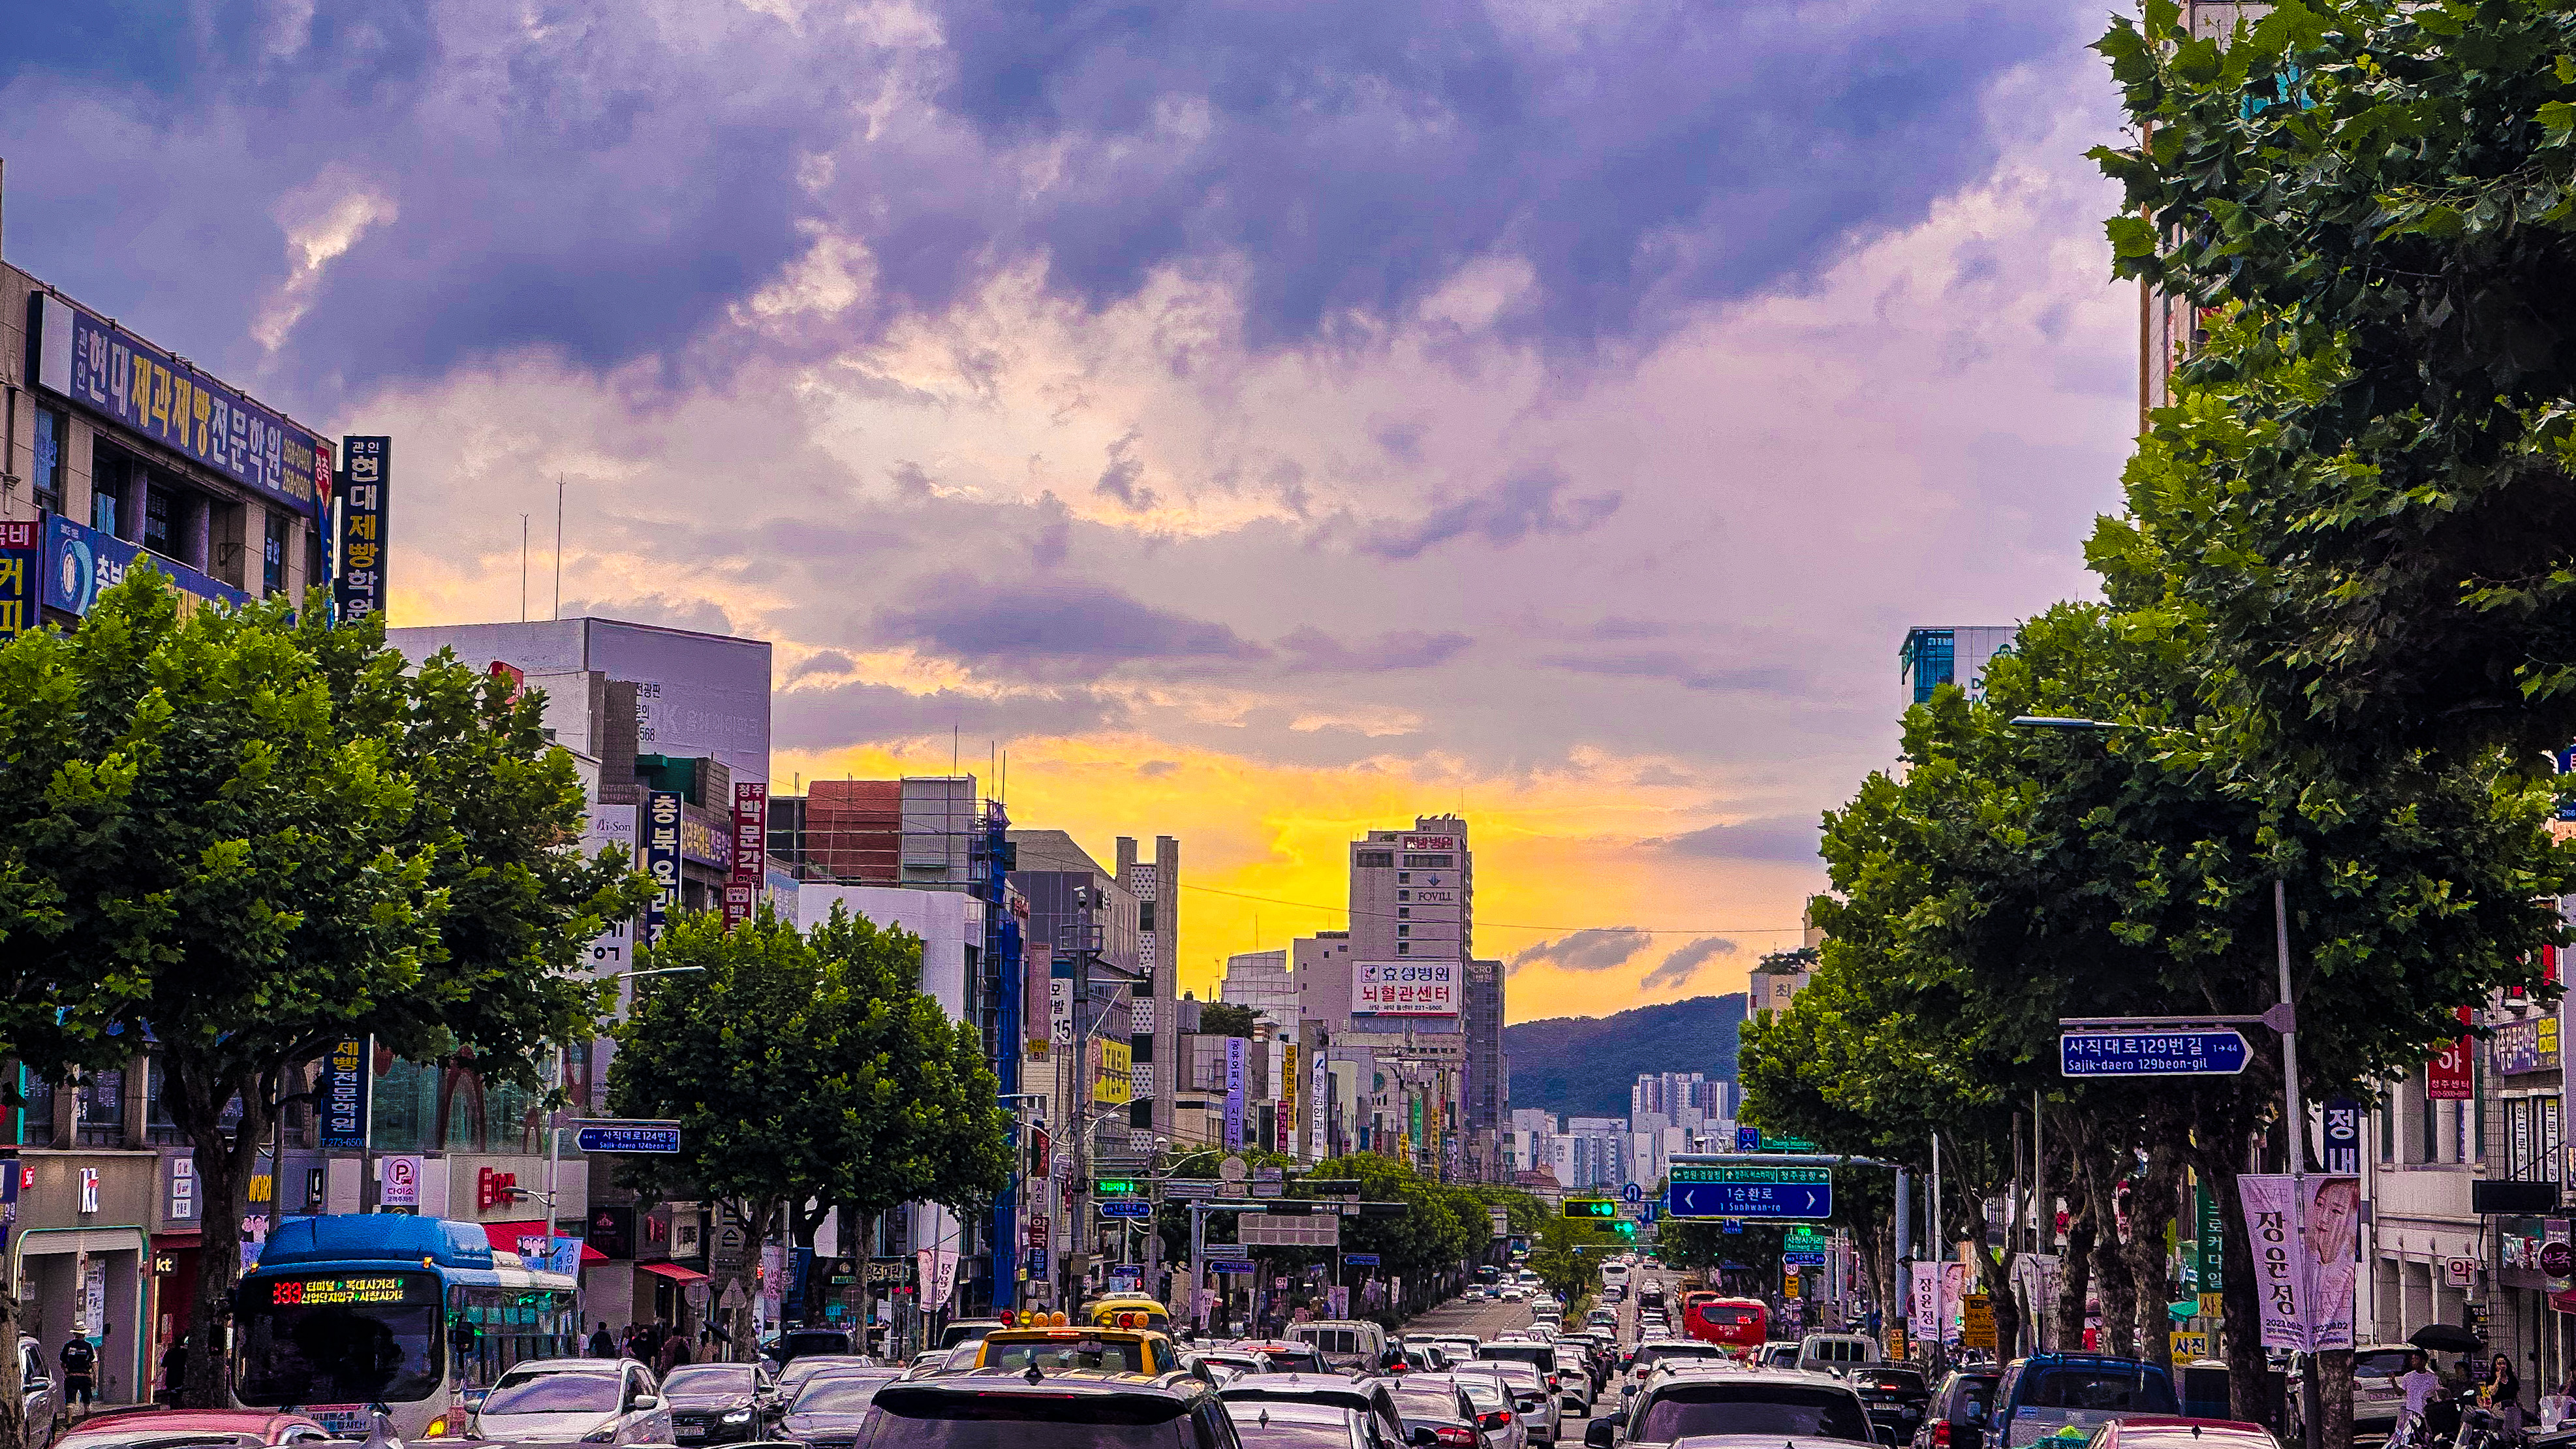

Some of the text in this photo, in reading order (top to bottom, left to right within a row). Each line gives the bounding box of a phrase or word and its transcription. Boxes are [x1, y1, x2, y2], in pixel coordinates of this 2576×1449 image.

[352, 441, 379, 454] 관인
[0, 524, 29, 546] 비
[347, 456, 379, 623] 현대제빵학원
[738, 784, 764, 798] 청주
[738, 800, 762, 873] 박문각
[1383, 967, 1450, 981] 효성병원
[1362, 986, 1450, 1003] 뇌혈관센터
[2068, 1038, 2203, 1056] 사직대로129번길
[2068, 1057, 2208, 1072] Sajik-daero 129beon-gil
[602, 1130, 676, 1142] 사직대로124번길
[1727, 1187, 1773, 1202] 1순환로
[155, 1258, 173, 1272] kt
[2254, 1211, 2296, 1316] 장윤정
[2450, 1260, 2473, 1283] 약
[273, 1281, 302, 1304] 333
[306, 1281, 335, 1292] 터미널
[1919, 1278, 1934, 1324] 장윤정
[2174, 1337, 2206, 1356] 사진
